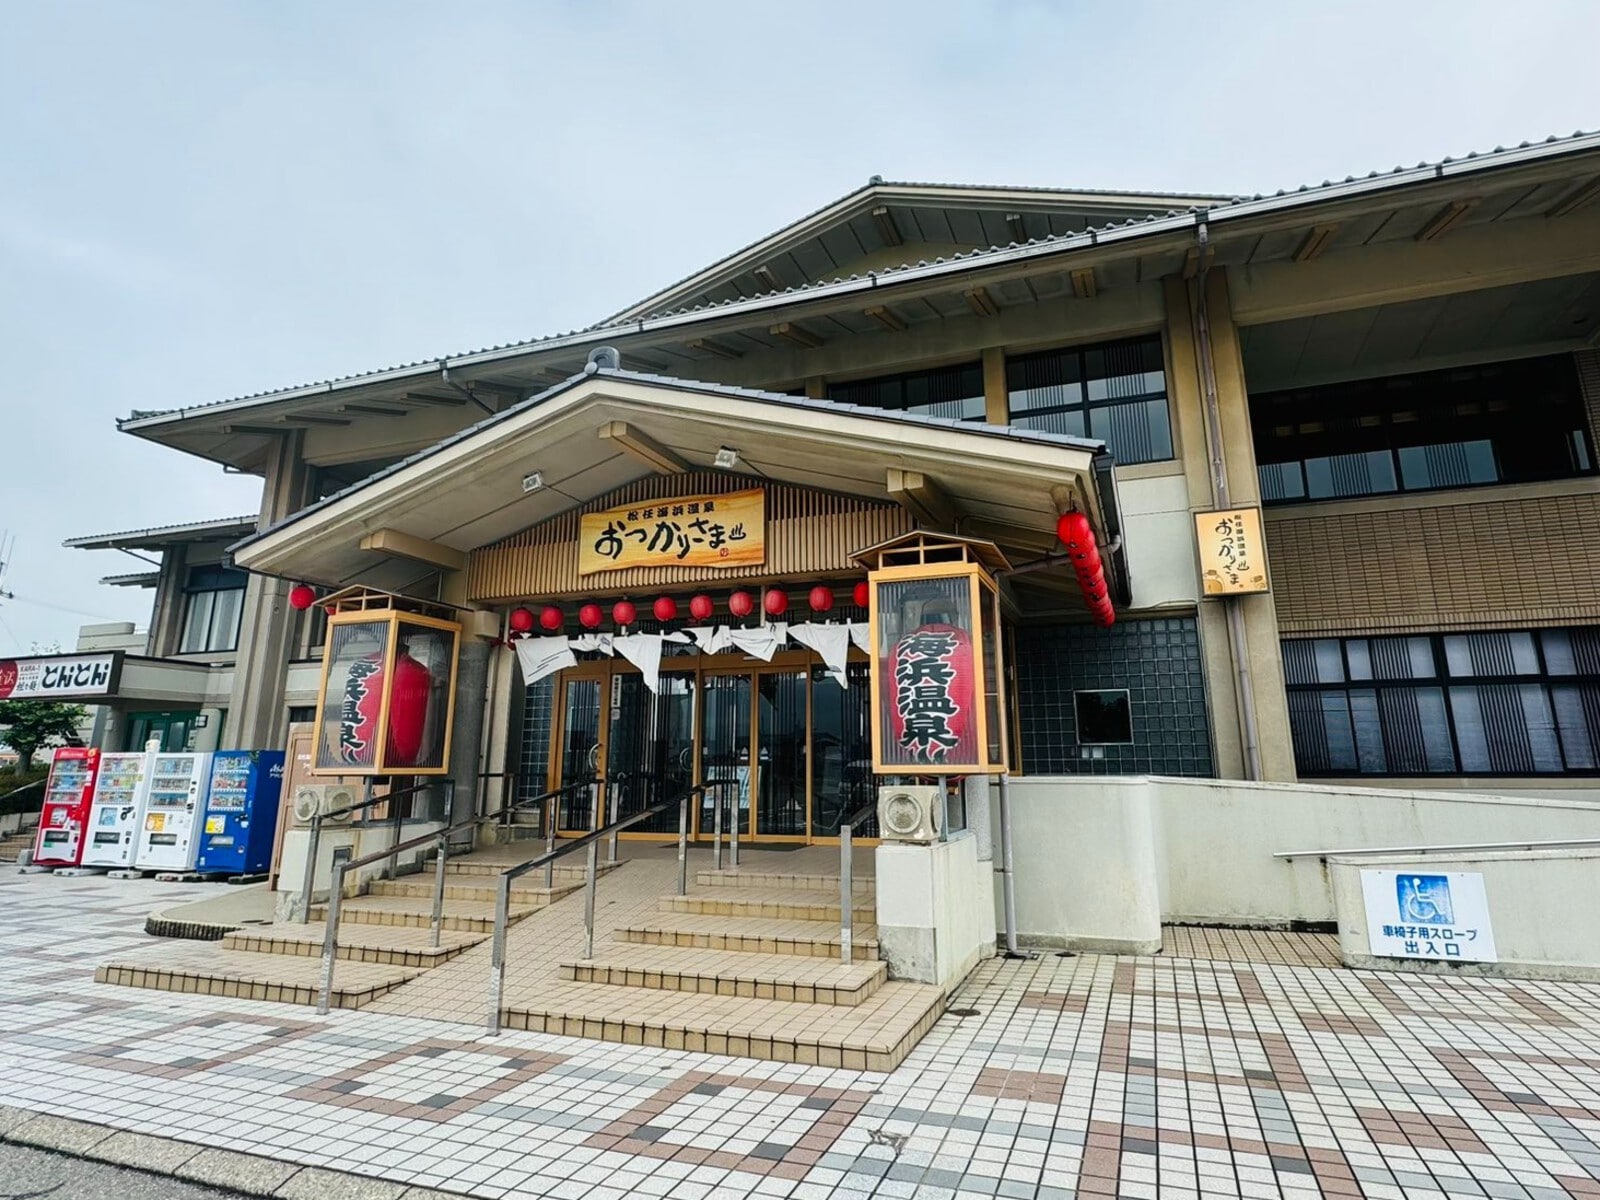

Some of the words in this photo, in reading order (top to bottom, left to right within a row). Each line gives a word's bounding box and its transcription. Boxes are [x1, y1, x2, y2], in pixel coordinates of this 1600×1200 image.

[42, 663, 109, 688] とんとん
[895, 631, 961, 750] 海浜温泉
[1382, 925, 1478, 941] 車椅子用スロープ
[1404, 941, 1460, 957] 出入口
